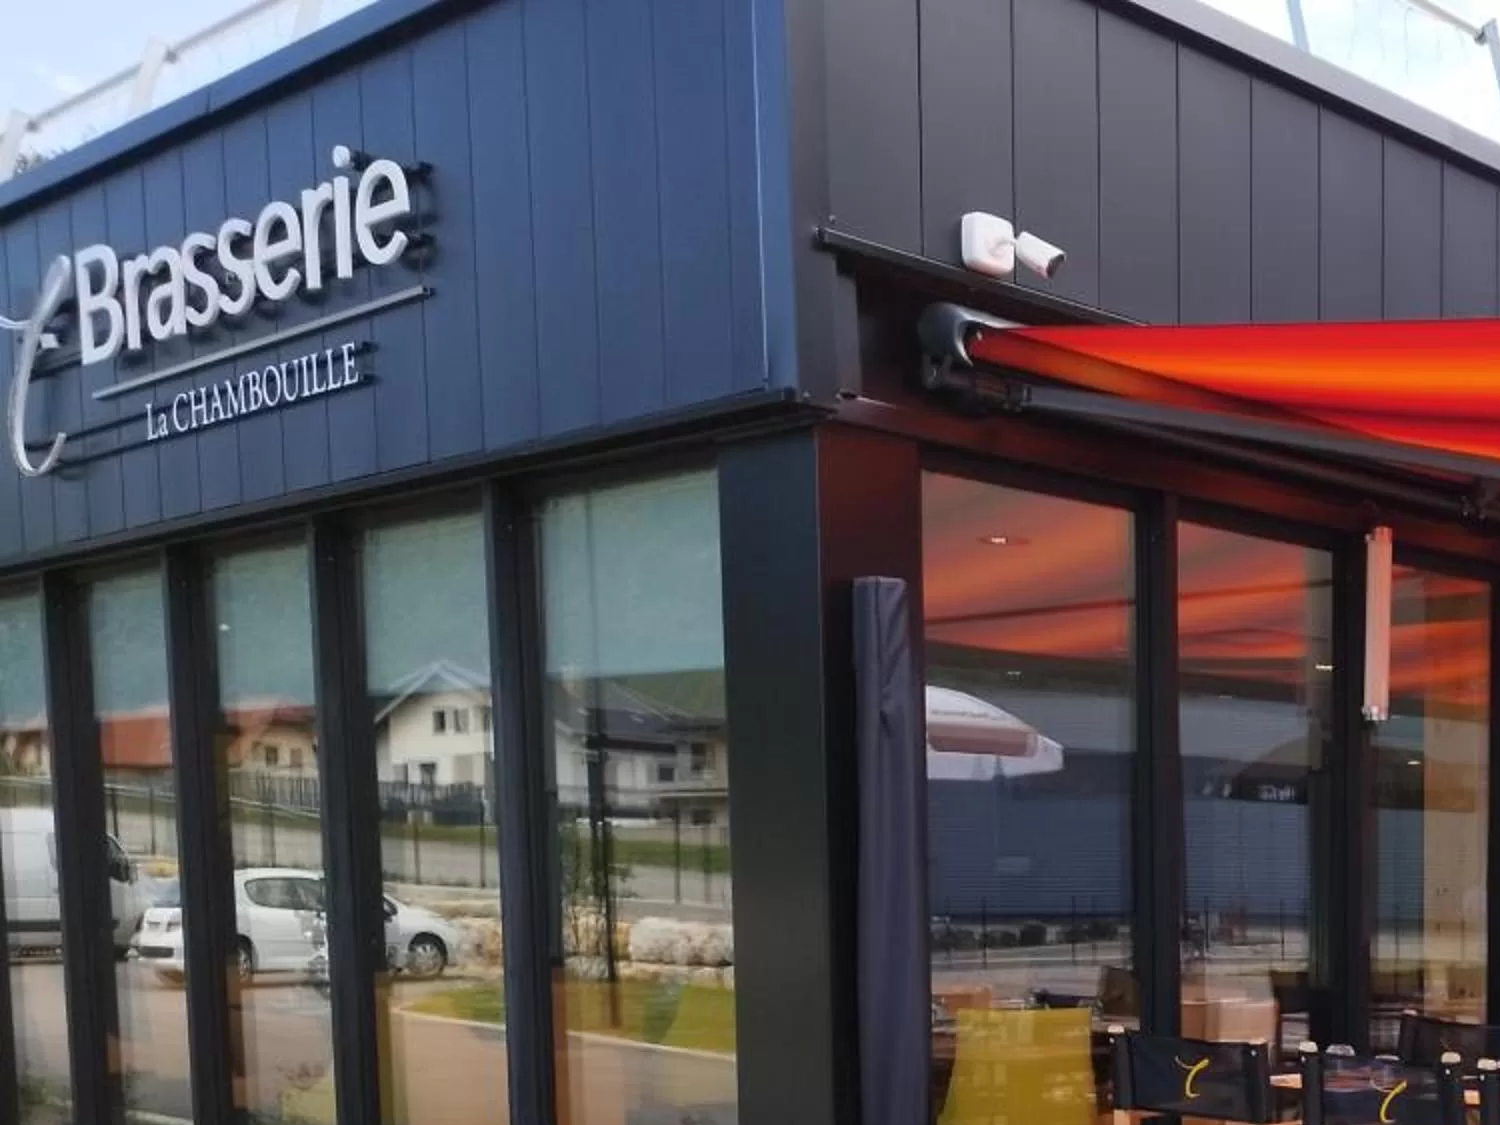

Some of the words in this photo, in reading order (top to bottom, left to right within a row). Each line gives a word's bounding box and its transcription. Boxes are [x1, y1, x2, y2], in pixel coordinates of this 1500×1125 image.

[74, 145, 411, 366] Brasserie
[145, 402, 169, 440] La
[172, 342, 360, 433] CHAMBOUILLE
